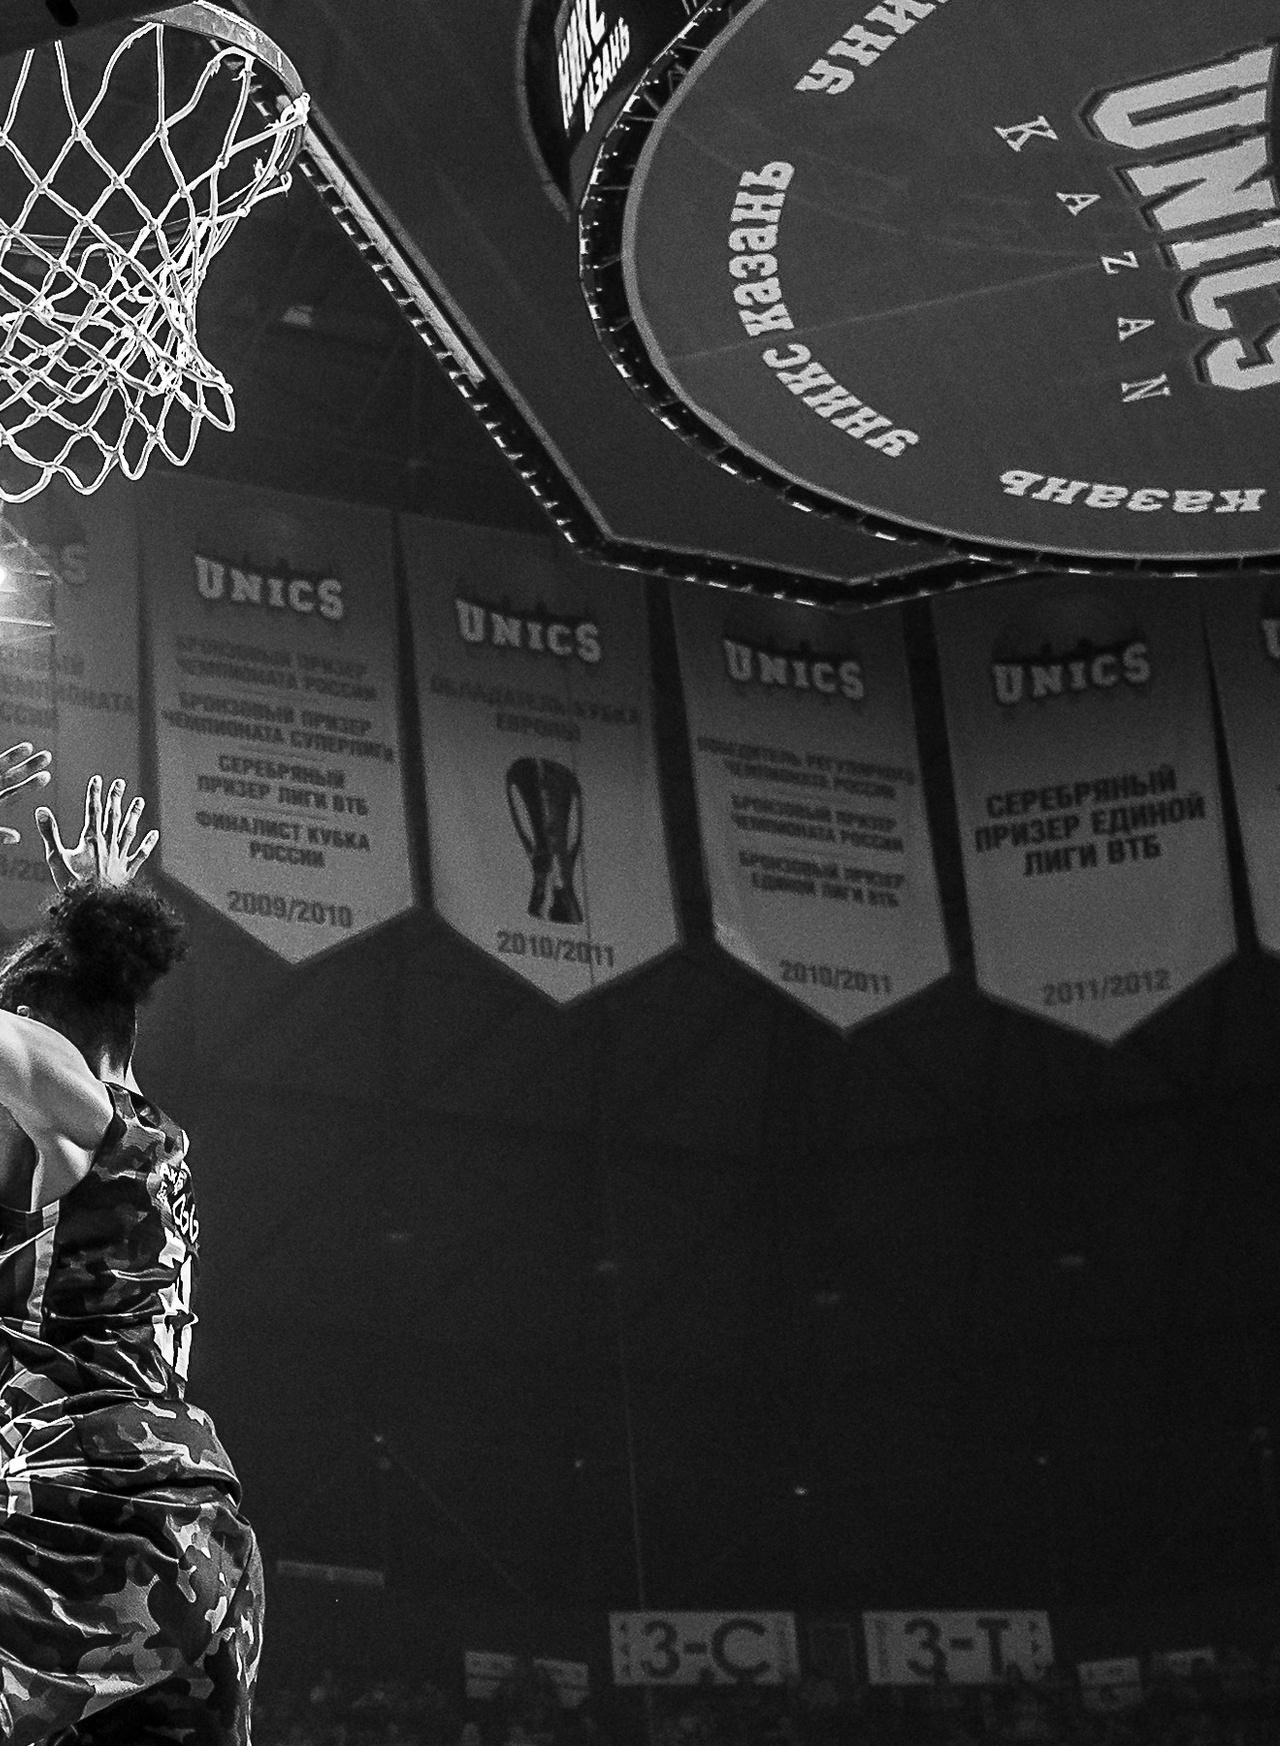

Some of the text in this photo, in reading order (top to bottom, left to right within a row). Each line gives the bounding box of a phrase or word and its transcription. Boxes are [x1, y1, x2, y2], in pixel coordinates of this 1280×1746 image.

[558, 0, 606, 130] НИКС
[194, 555, 344, 621] UNICS
[455, 597, 602, 664] UNICS
[722, 638, 867, 702] UNICS
[990, 643, 1151, 706] UNICS
[218, 754, 346, 789] СЕРЕБРЯНЫЙ
[984, 764, 1178, 818] СЕРЕБРЯНЫЙ
[197, 773, 370, 817] ПРИЗЕР ЛИГИ ВТБ
[195, 809, 371, 853] ФИНАЛИСТ КУБКА
[974, 792, 1207, 854] ПРИЗЕР ЕДИНОЙ
[249, 840, 326, 869] РОССИИ
[1024, 834, 1163, 879] ЛИГИ ВТБ
[227, 889, 355, 930] 2009/2010
[496, 930, 615, 969] 2010/2011
[778, 958, 894, 996] 2010/2011
[1041, 968, 1173, 1007] 2011/2012
